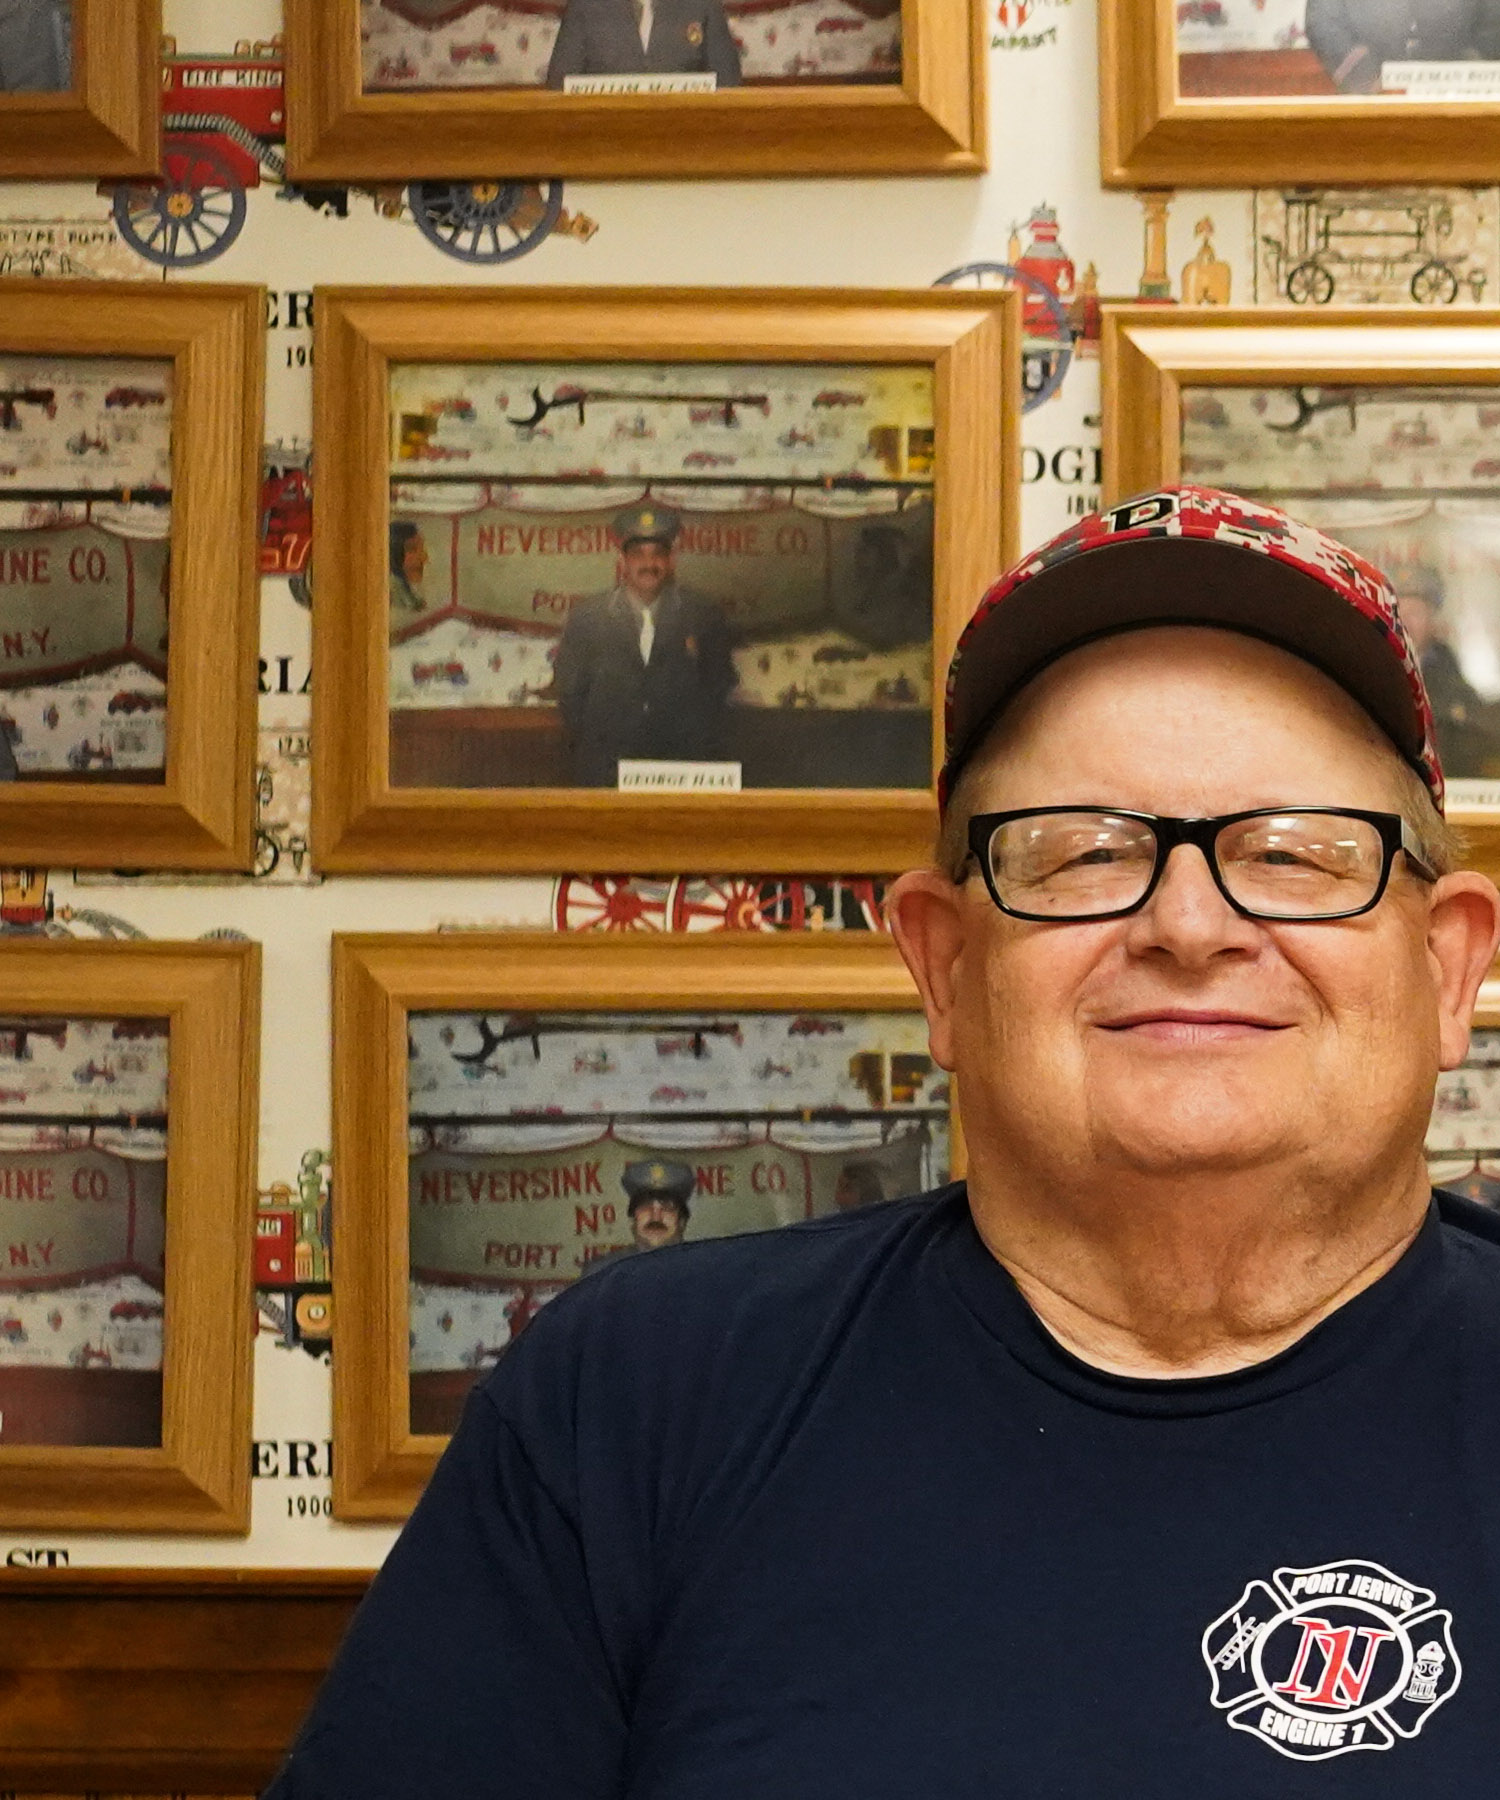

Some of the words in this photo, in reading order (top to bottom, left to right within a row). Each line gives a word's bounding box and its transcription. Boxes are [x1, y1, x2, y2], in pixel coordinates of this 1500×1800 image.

[477, 522, 621, 558] NEVERSIN
[677, 521, 763, 557] NGINE
[0, 546, 51, 585] INE
[623, 773, 687, 788] GEORGE
[0, 1167, 55, 1202] INE
[419, 1161, 604, 1206] NEVERSINK
[484, 1242, 562, 1269] PORT
[1290, 1572, 1349, 1598] PORT
[1349, 1574, 1416, 1612] JERVIS
[1259, 1707, 1348, 1747] ENGINE
[1349, 1722, 1367, 1745] 1
